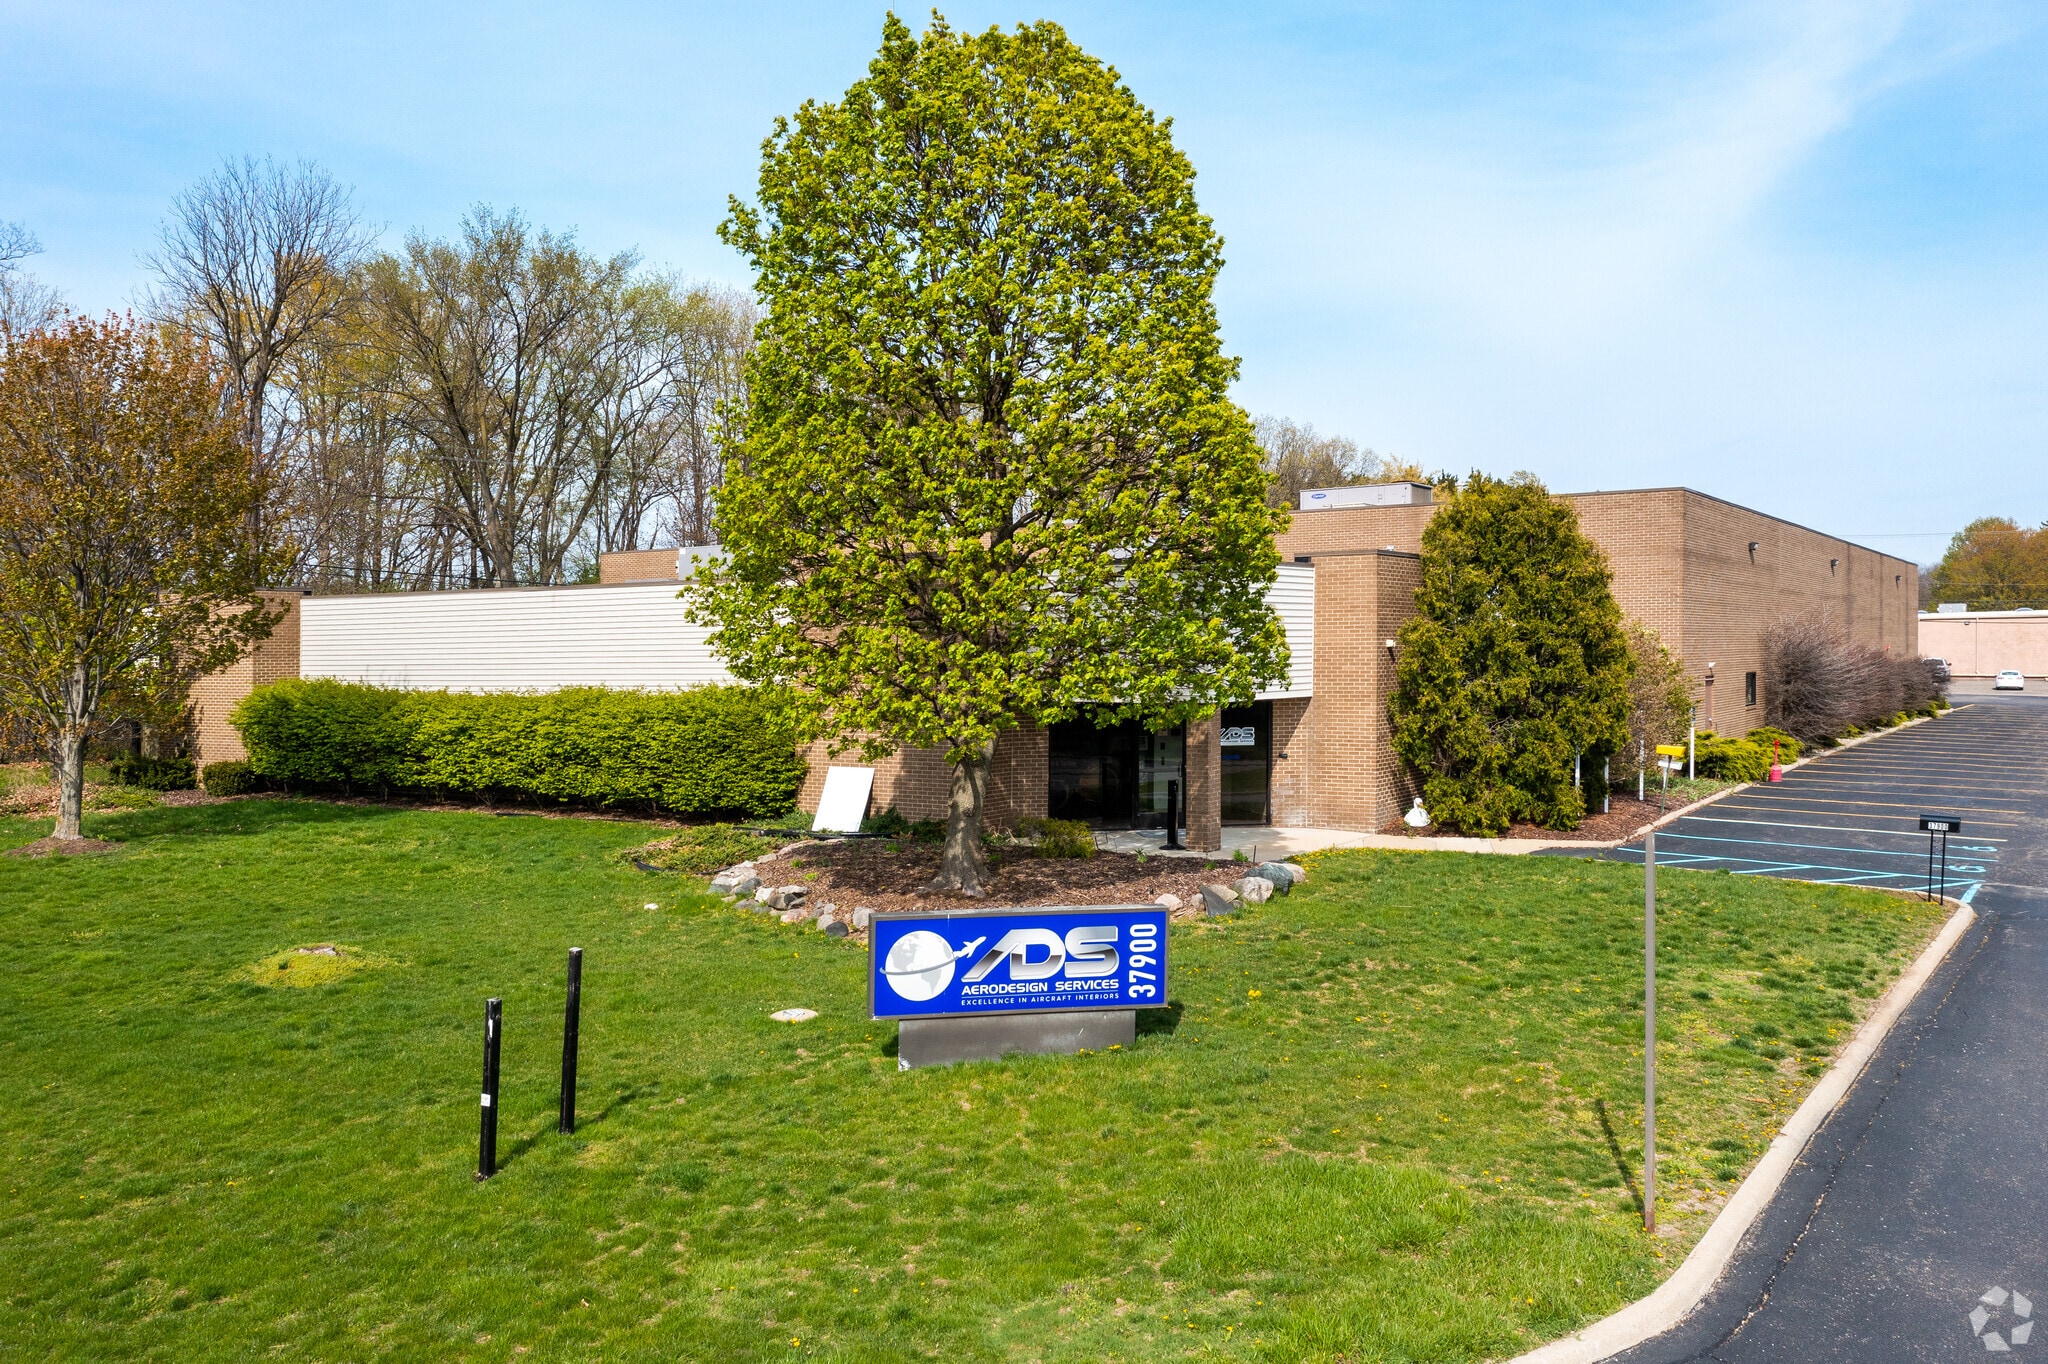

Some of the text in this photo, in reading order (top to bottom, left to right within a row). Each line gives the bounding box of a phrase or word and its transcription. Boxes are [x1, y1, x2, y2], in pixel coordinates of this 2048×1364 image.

[1220, 727, 1255, 740] ADS
[961, 926, 1119, 982] ADS
[1129, 924, 1157, 998] 37900
[961, 979, 1119, 996] AERODESIGN SERVICES
[961, 997, 1015, 1006] EXCELLENCE
[1075, 992, 1119, 1001] INTERIORS
